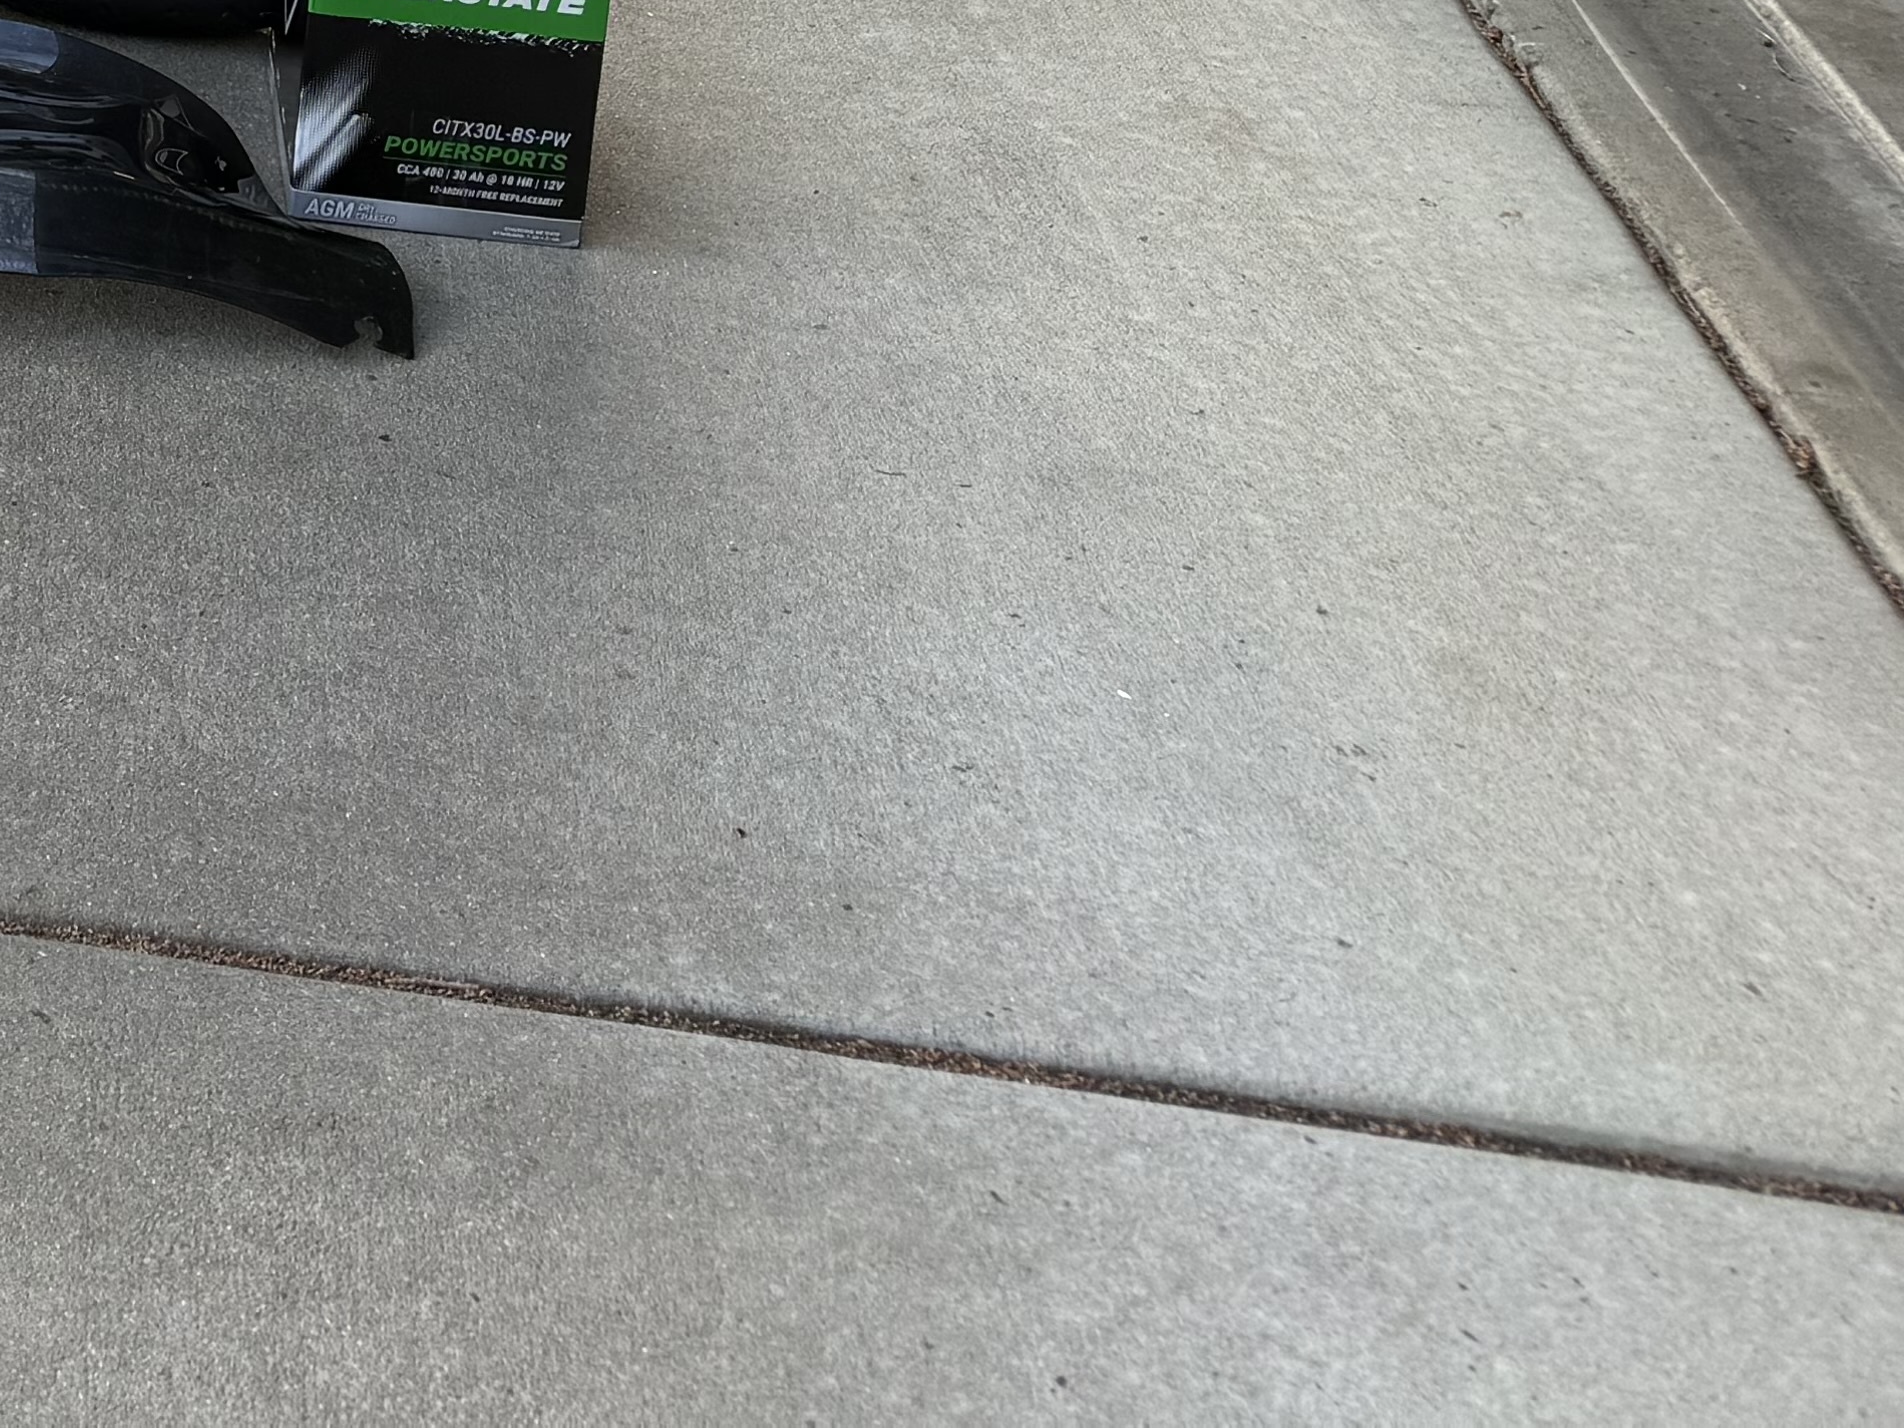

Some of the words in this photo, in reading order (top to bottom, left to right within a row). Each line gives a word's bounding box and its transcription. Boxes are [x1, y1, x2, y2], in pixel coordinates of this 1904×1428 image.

[432, 118, 572, 149] CITX30L-BS-PW
[384, 135, 569, 173] POWERSPORTS
[396, 163, 419, 178] CCA
[451, 168, 466, 182] 30
[468, 170, 484, 184] Ah
[542, 178, 566, 193] 12V
[304, 197, 355, 220] AGM
[429, 184, 473, 200] 12-MONTH
[475, 188, 498, 201] FREE
[499, 191, 564, 209] REPLACEMENT
